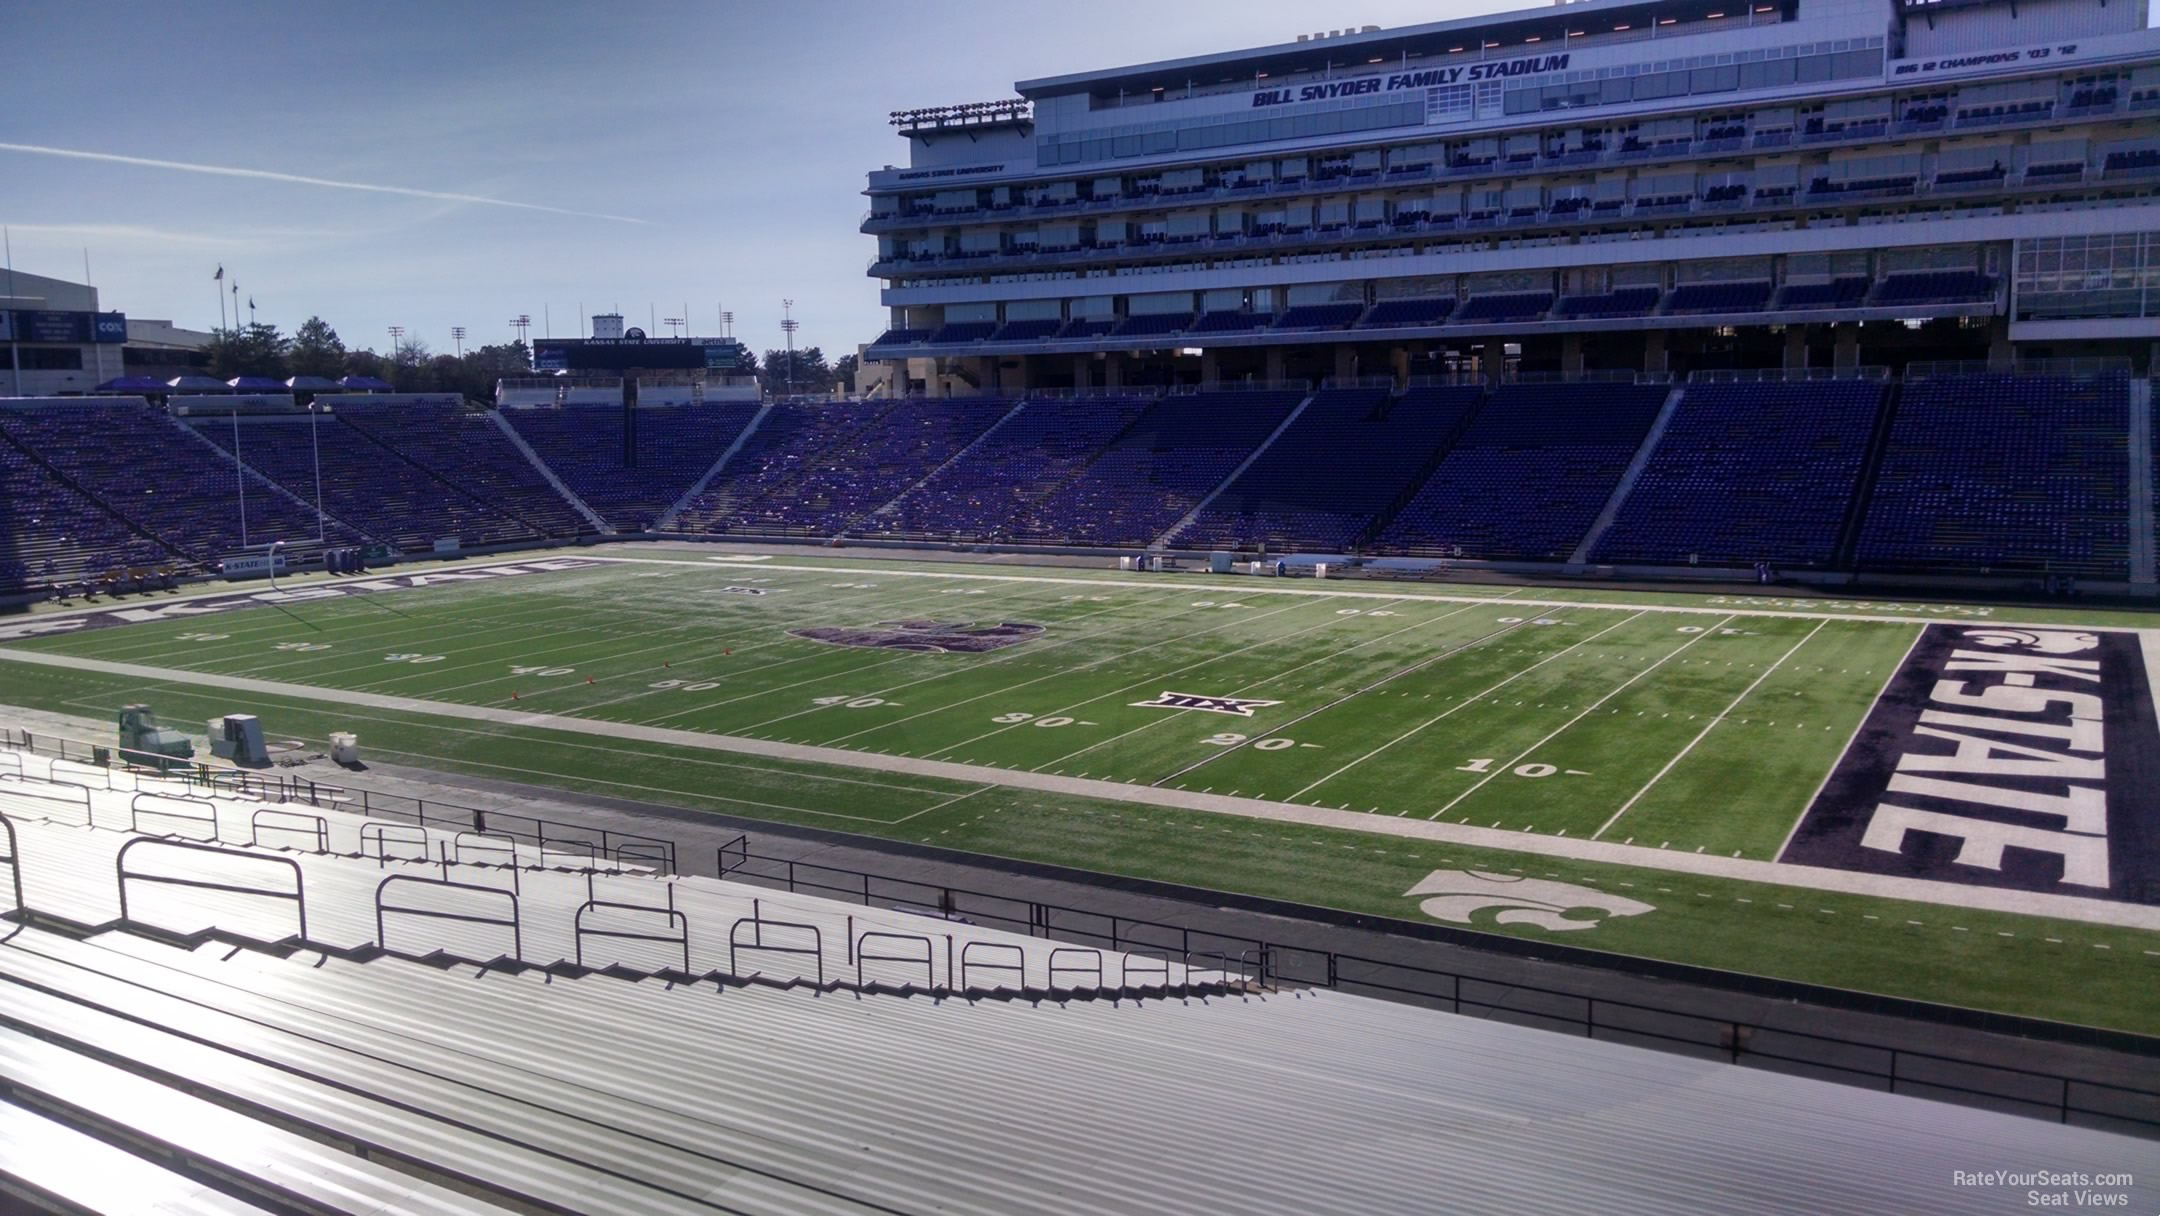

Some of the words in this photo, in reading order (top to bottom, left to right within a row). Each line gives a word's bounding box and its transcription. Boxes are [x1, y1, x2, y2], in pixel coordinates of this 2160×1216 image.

[1895, 63, 1918, 75] BIG
[1921, 61, 1937, 71] 12
[1939, 51, 2020, 70] CHAMPIONS
[1252, 89, 1294, 108] BILL
[1300, 78, 1382, 102] SNYDER
[1387, 66, 1464, 91] FAMILY
[1468, 54, 1570, 80] STADIUM
[898, 170, 930, 181] KANSAS
[931, 168, 955, 178] STATE
[956, 164, 1005, 176] UNIVERSITY
[98, 320, 124, 334] COX
[701, 338, 726, 346] aetna
[114, 558, 603, 621] K-STATE
[648, 678, 721, 691] 50
[812, 695, 886, 709] 40
[991, 712, 1075, 728] 30
[1199, 733, 1295, 751] 20
[1456, 758, 1558, 777] 10
[1860, 649, 2109, 888] K-STATE
